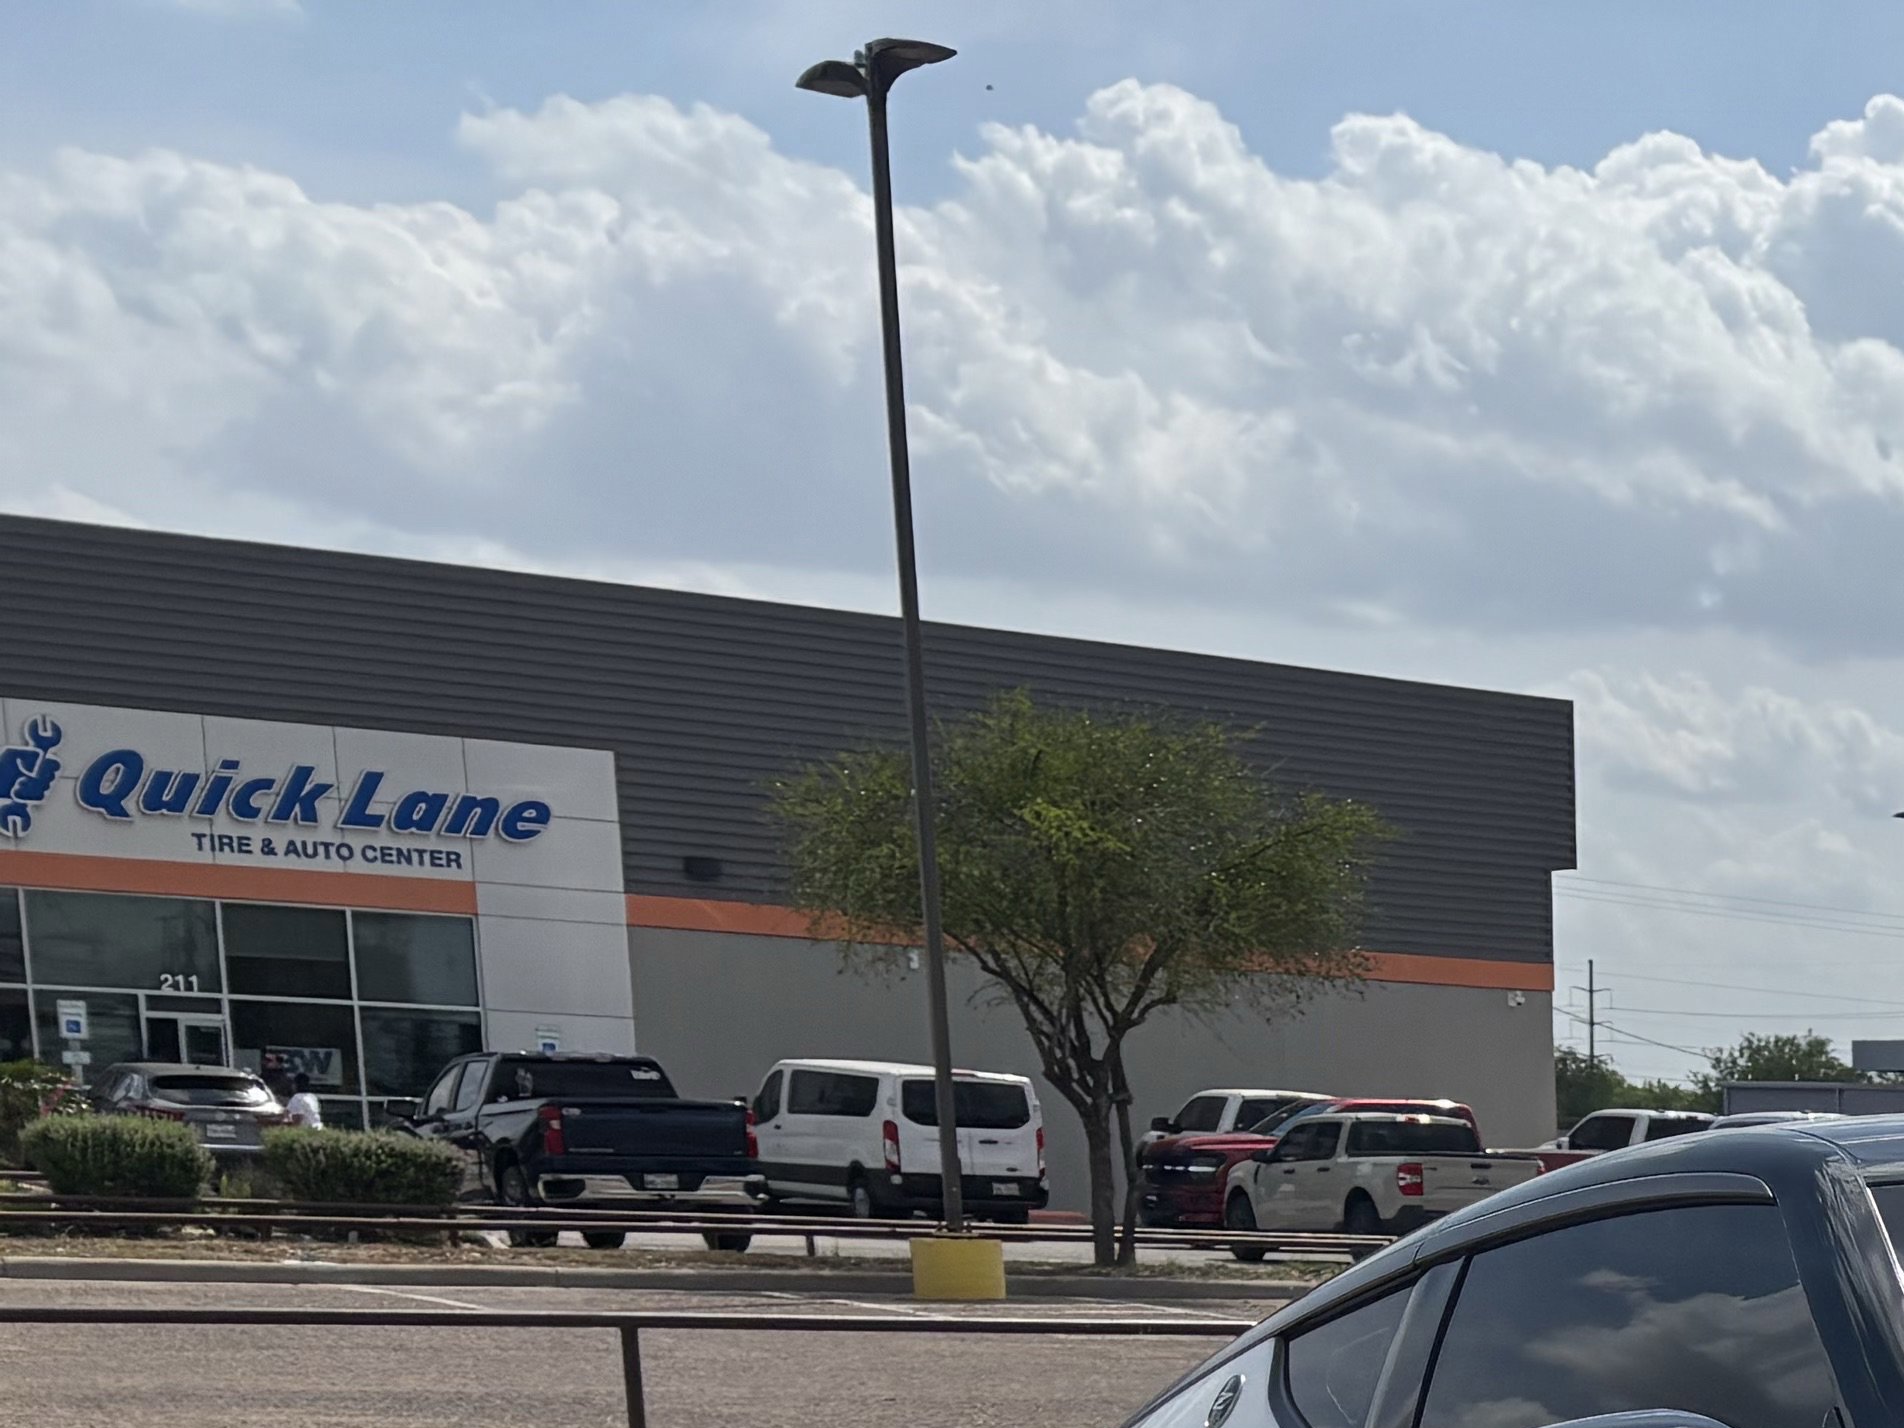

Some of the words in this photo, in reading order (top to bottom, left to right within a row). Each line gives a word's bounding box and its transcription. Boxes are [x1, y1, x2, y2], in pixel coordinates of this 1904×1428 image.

[78, 748, 334, 823] Quick
[340, 771, 552, 841] Lane
[191, 832, 252, 855] TIRE
[260, 837, 277, 856] &
[284, 839, 355, 862] AUTO
[360, 845, 463, 869] CENTER
[159, 973, 199, 993] 211
